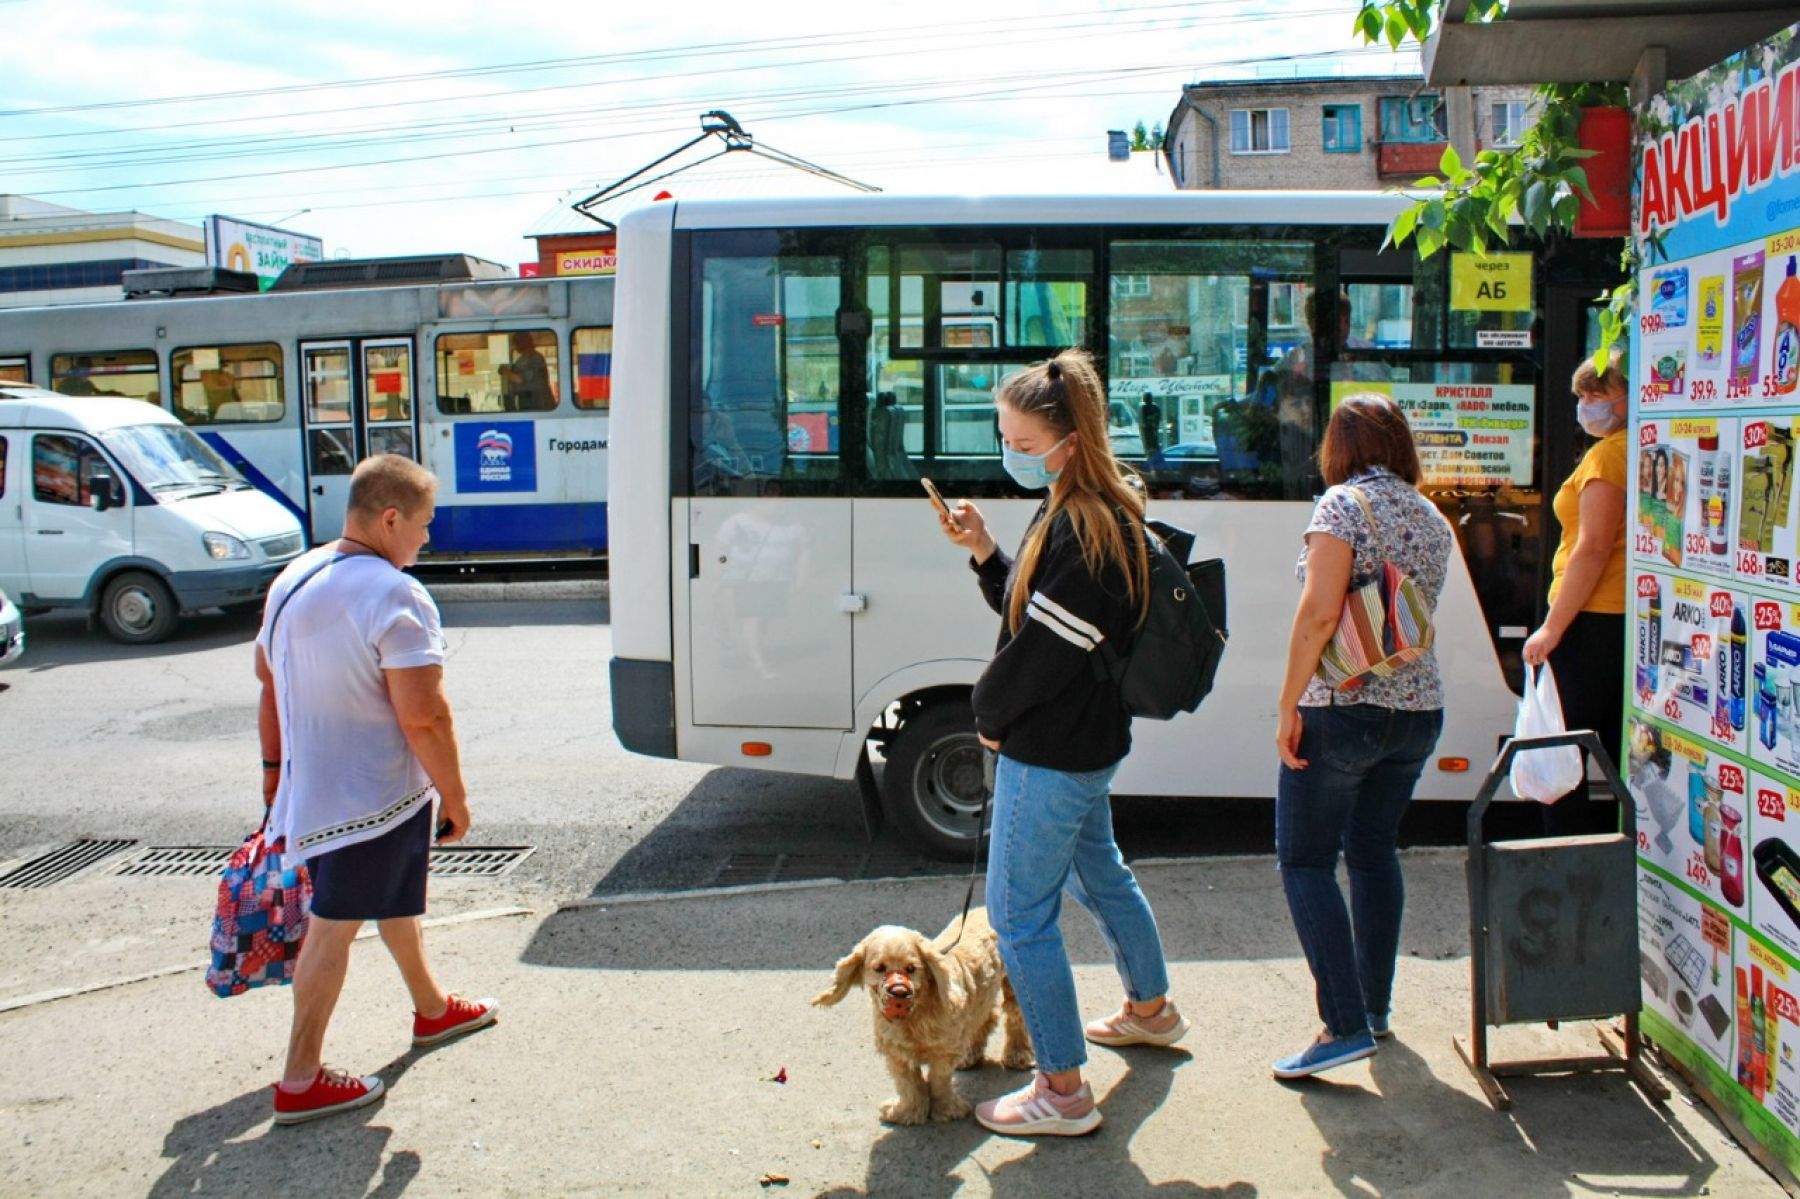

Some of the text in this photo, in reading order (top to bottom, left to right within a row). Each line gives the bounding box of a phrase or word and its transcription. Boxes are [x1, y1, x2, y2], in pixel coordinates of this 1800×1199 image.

[257, 251, 288, 270] ЗАЙМ
[1475, 262, 1509, 272] через
[1476, 281, 1507, 299] АБ
[1436, 387, 1492, 398] КРИСТАЛЛ
[1491, 402, 1530, 412] мебель
[1425, 434, 1463, 445] ЛЕНТА
[1472, 434, 1509, 445] Вокзал
[1464, 450, 1505, 460] Советов
[1672, 601, 1701, 627] ARKO
[1755, 606, 1780, 627] -25%
[1639, 624, 1647, 666] ARKO
[1649, 621, 1658, 665] ARKO
[1718, 650, 1727, 697] ARKO
[1731, 650, 1742, 700] ARKO
[1719, 770, 1745, 790] -25%
[1758, 793, 1784, 815] -25%
